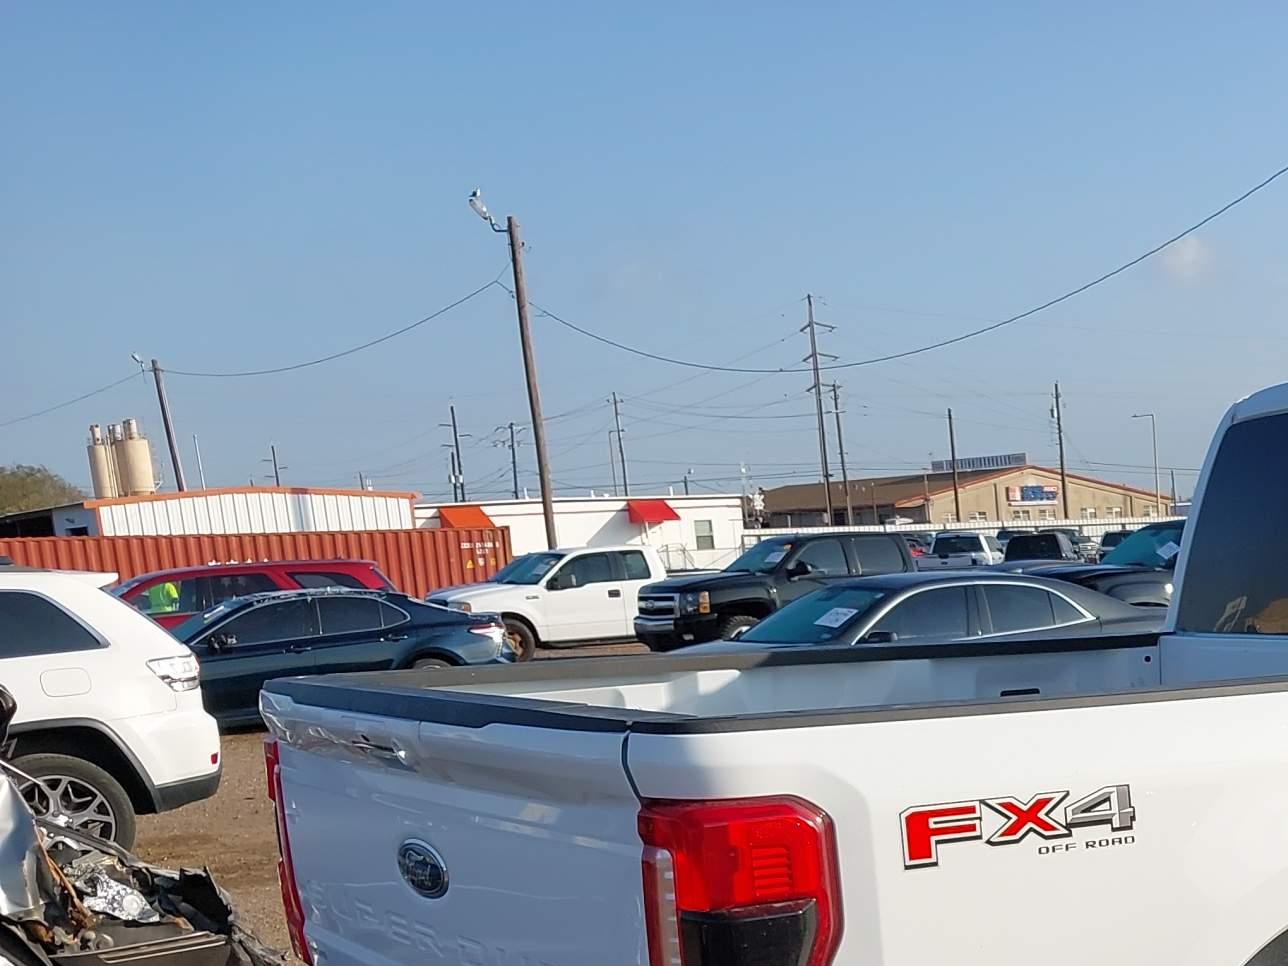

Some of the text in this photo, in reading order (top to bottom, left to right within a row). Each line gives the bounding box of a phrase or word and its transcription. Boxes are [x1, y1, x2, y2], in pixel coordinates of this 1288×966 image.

[899, 784, 1136, 870] FX4
[1038, 835, 1136, 855] OFF ROAD
